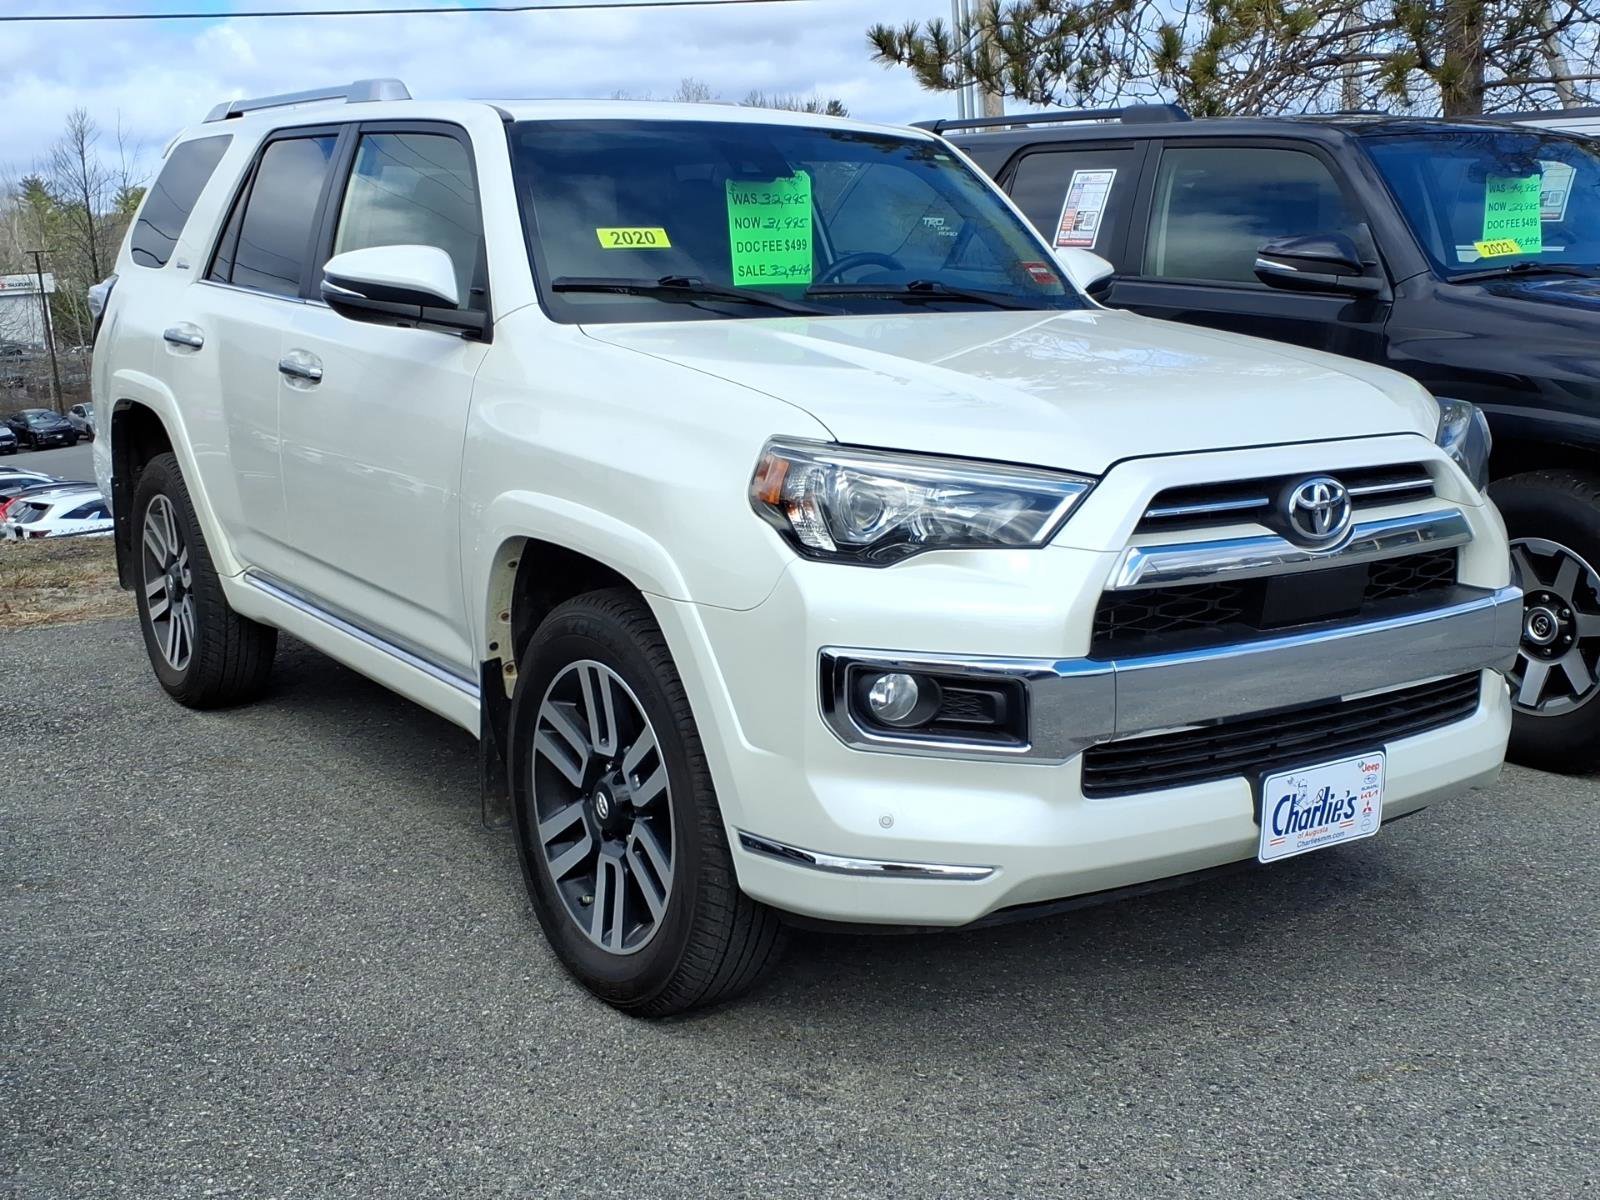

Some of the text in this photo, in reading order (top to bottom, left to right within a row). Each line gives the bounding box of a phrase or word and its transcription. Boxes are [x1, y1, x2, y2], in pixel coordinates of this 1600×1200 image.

[1490, 184, 1506, 193] WAS
[732, 193, 757, 205] WAS
[1489, 201, 1507, 211] NOW
[735, 217, 760, 229] NOW
[1487, 217, 1537, 229] DOC FEE $499
[610, 231, 656, 245] 2020
[736, 238, 807, 253] DOC FEE $499
[1484, 242, 1514, 254] 2023
[738, 264, 766, 277] SALE
[1362, 763, 1380, 773] Jeep
[1272, 786, 1357, 836] Charlie's
